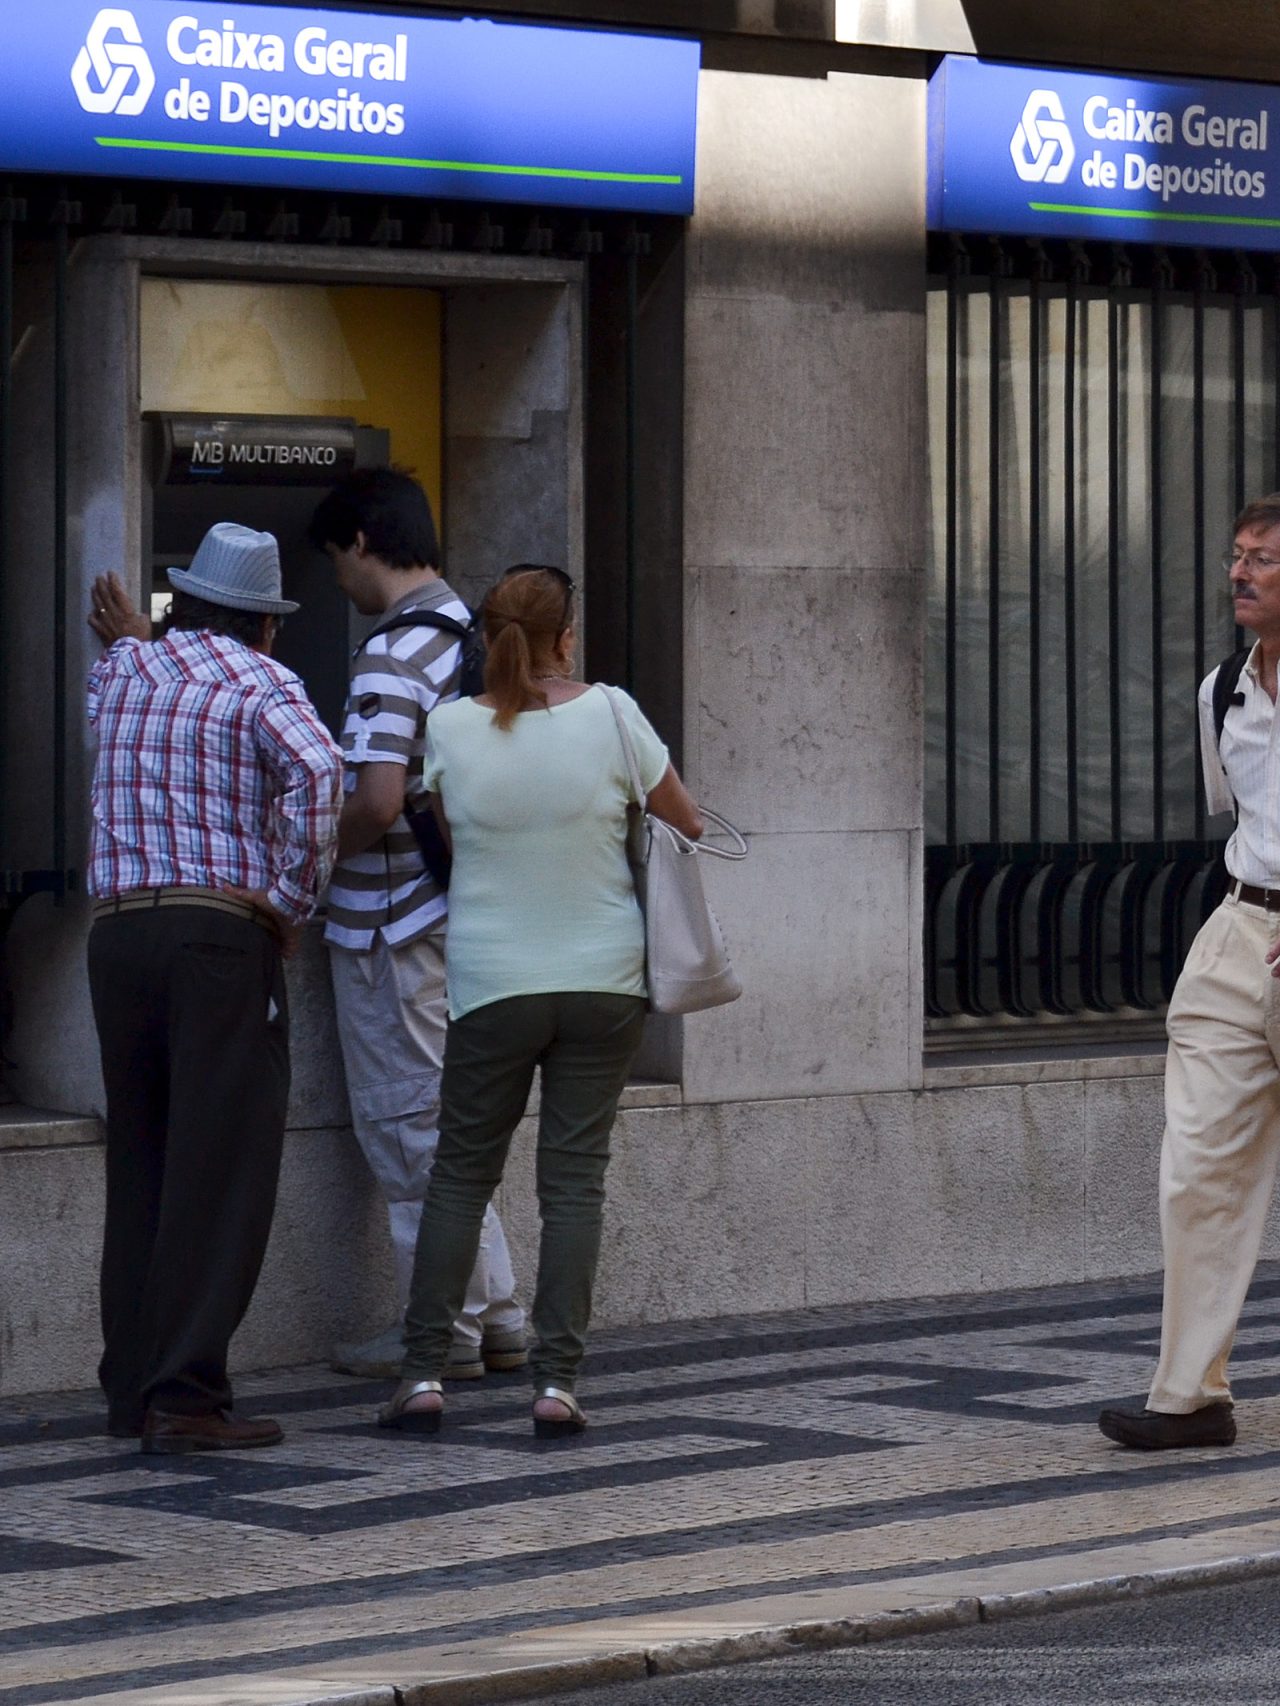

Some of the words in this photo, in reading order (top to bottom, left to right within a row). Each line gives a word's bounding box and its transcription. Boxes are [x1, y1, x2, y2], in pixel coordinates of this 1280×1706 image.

[167, 16, 285, 72] Caixa
[294, 27, 408, 81] Geral
[165, 78, 211, 122] de
[1082, 96, 1173, 144] Caixa
[1182, 105, 1268, 151] Geral
[1081, 151, 1117, 189] de
[192, 441, 224, 463] MB
[228, 444, 337, 465] MULTIBANCO
